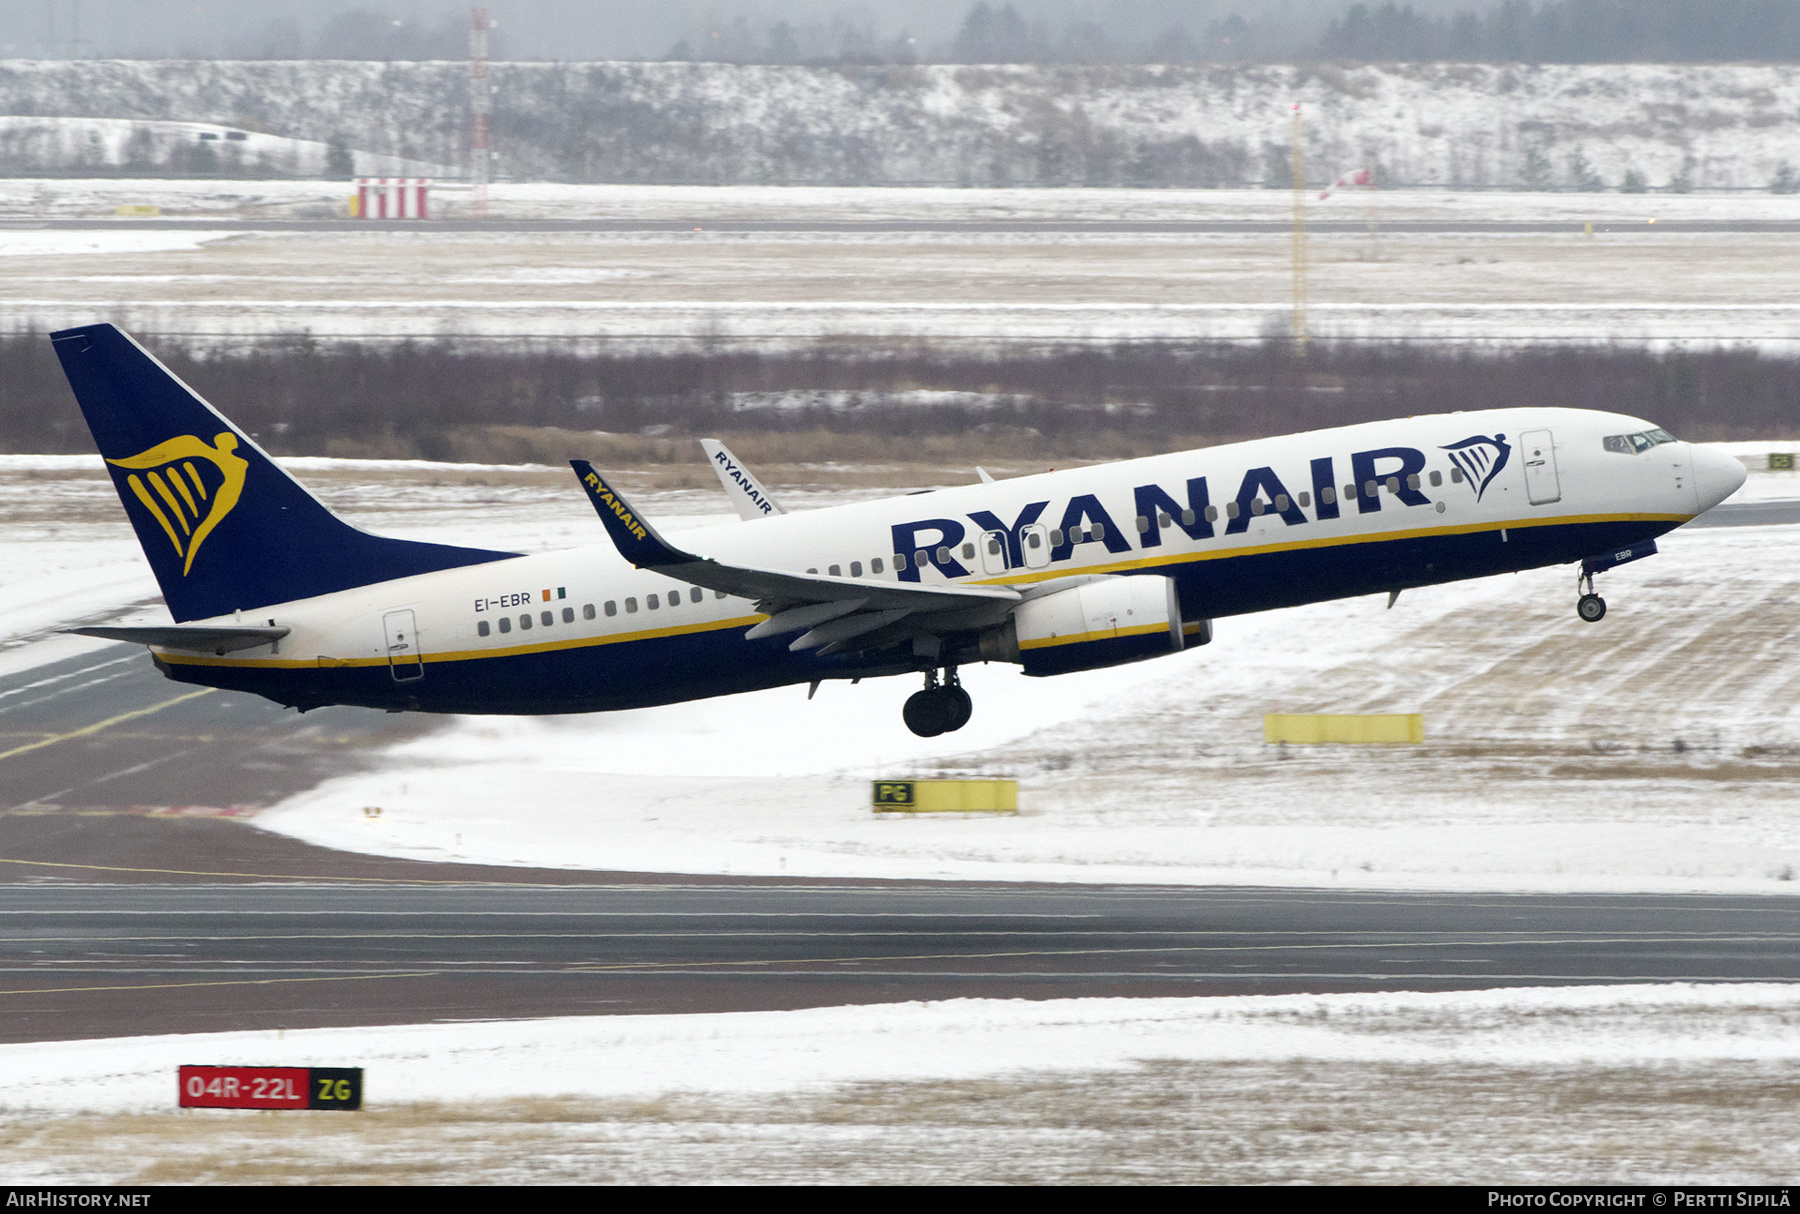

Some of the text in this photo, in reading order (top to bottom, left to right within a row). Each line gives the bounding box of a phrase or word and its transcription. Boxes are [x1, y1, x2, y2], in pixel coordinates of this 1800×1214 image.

[714, 451, 773, 516] RYANAIR
[584, 472, 647, 541] RYANAIR
[891, 447, 1432, 583] RYANAIR
[1615, 549, 1632, 561] EBR
[474, 592, 532, 613] EI-EBR
[186, 1076, 352, 1101] 04R-22L ZG
